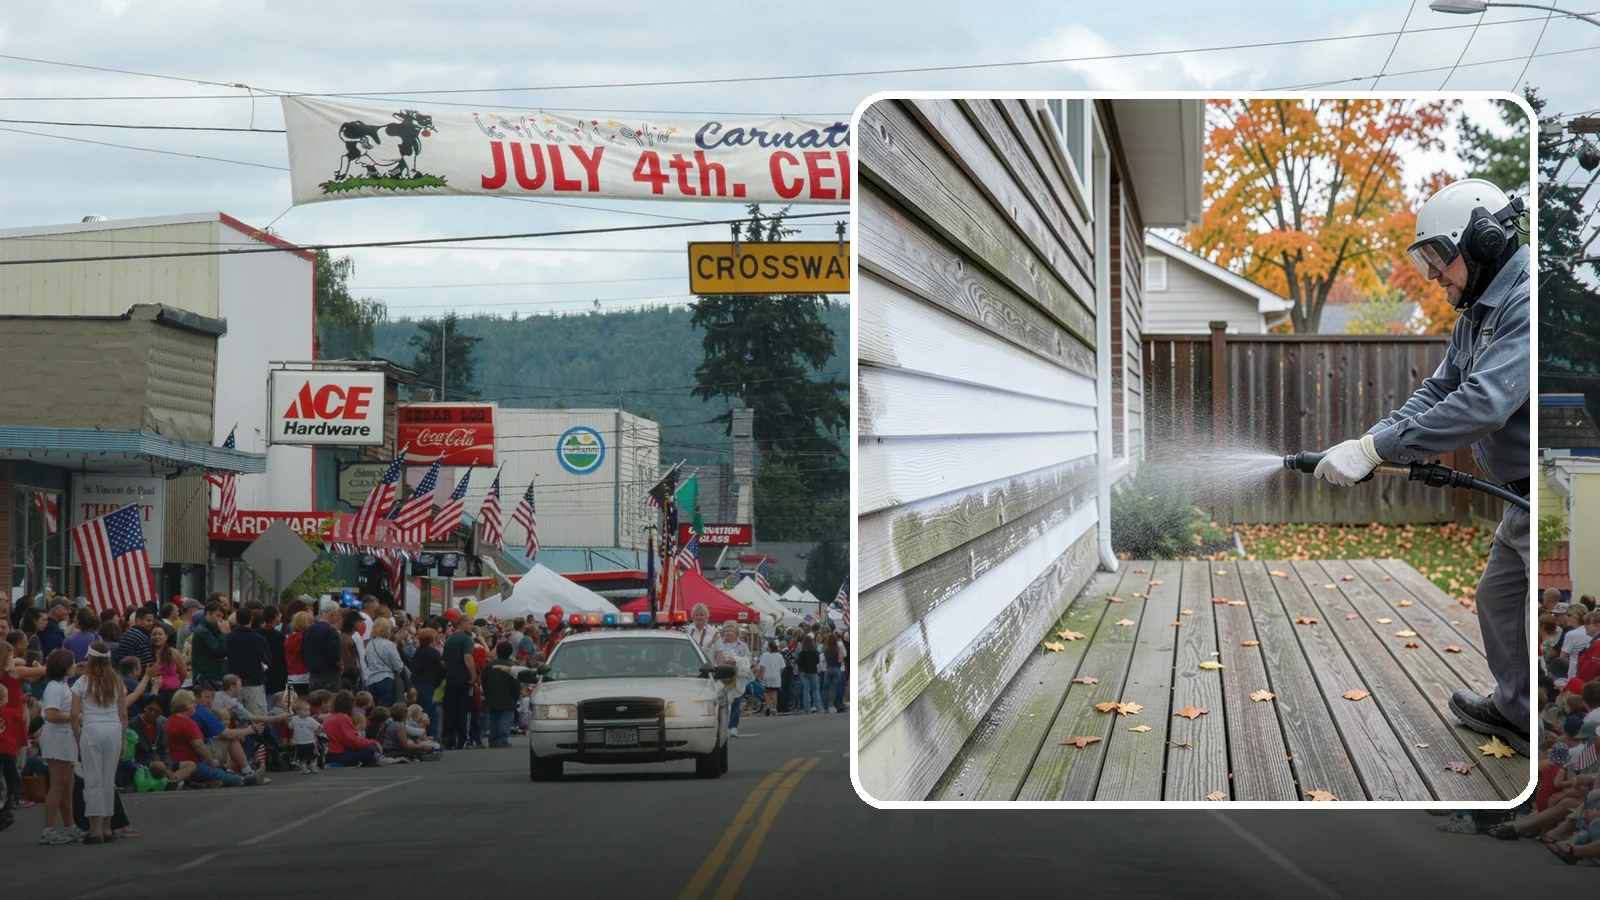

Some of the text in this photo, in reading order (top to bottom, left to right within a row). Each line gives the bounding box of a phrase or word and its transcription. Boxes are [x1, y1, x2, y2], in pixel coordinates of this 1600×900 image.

[481, 141, 605, 193] JULY
[632, 150, 746, 198] 4th.
[697, 254, 850, 280] CROSSWA
[282, 380, 373, 420] ACE
[405, 409, 485, 422] CEDAR LOG
[283, 421, 371, 437] Hardware
[416, 428, 477, 447] Coca-Cola
[96, 485, 124, 494] Vincent
[126, 486, 136, 494] de
[138, 486, 155, 495] Paul
[699, 535, 730, 543] GLASS
